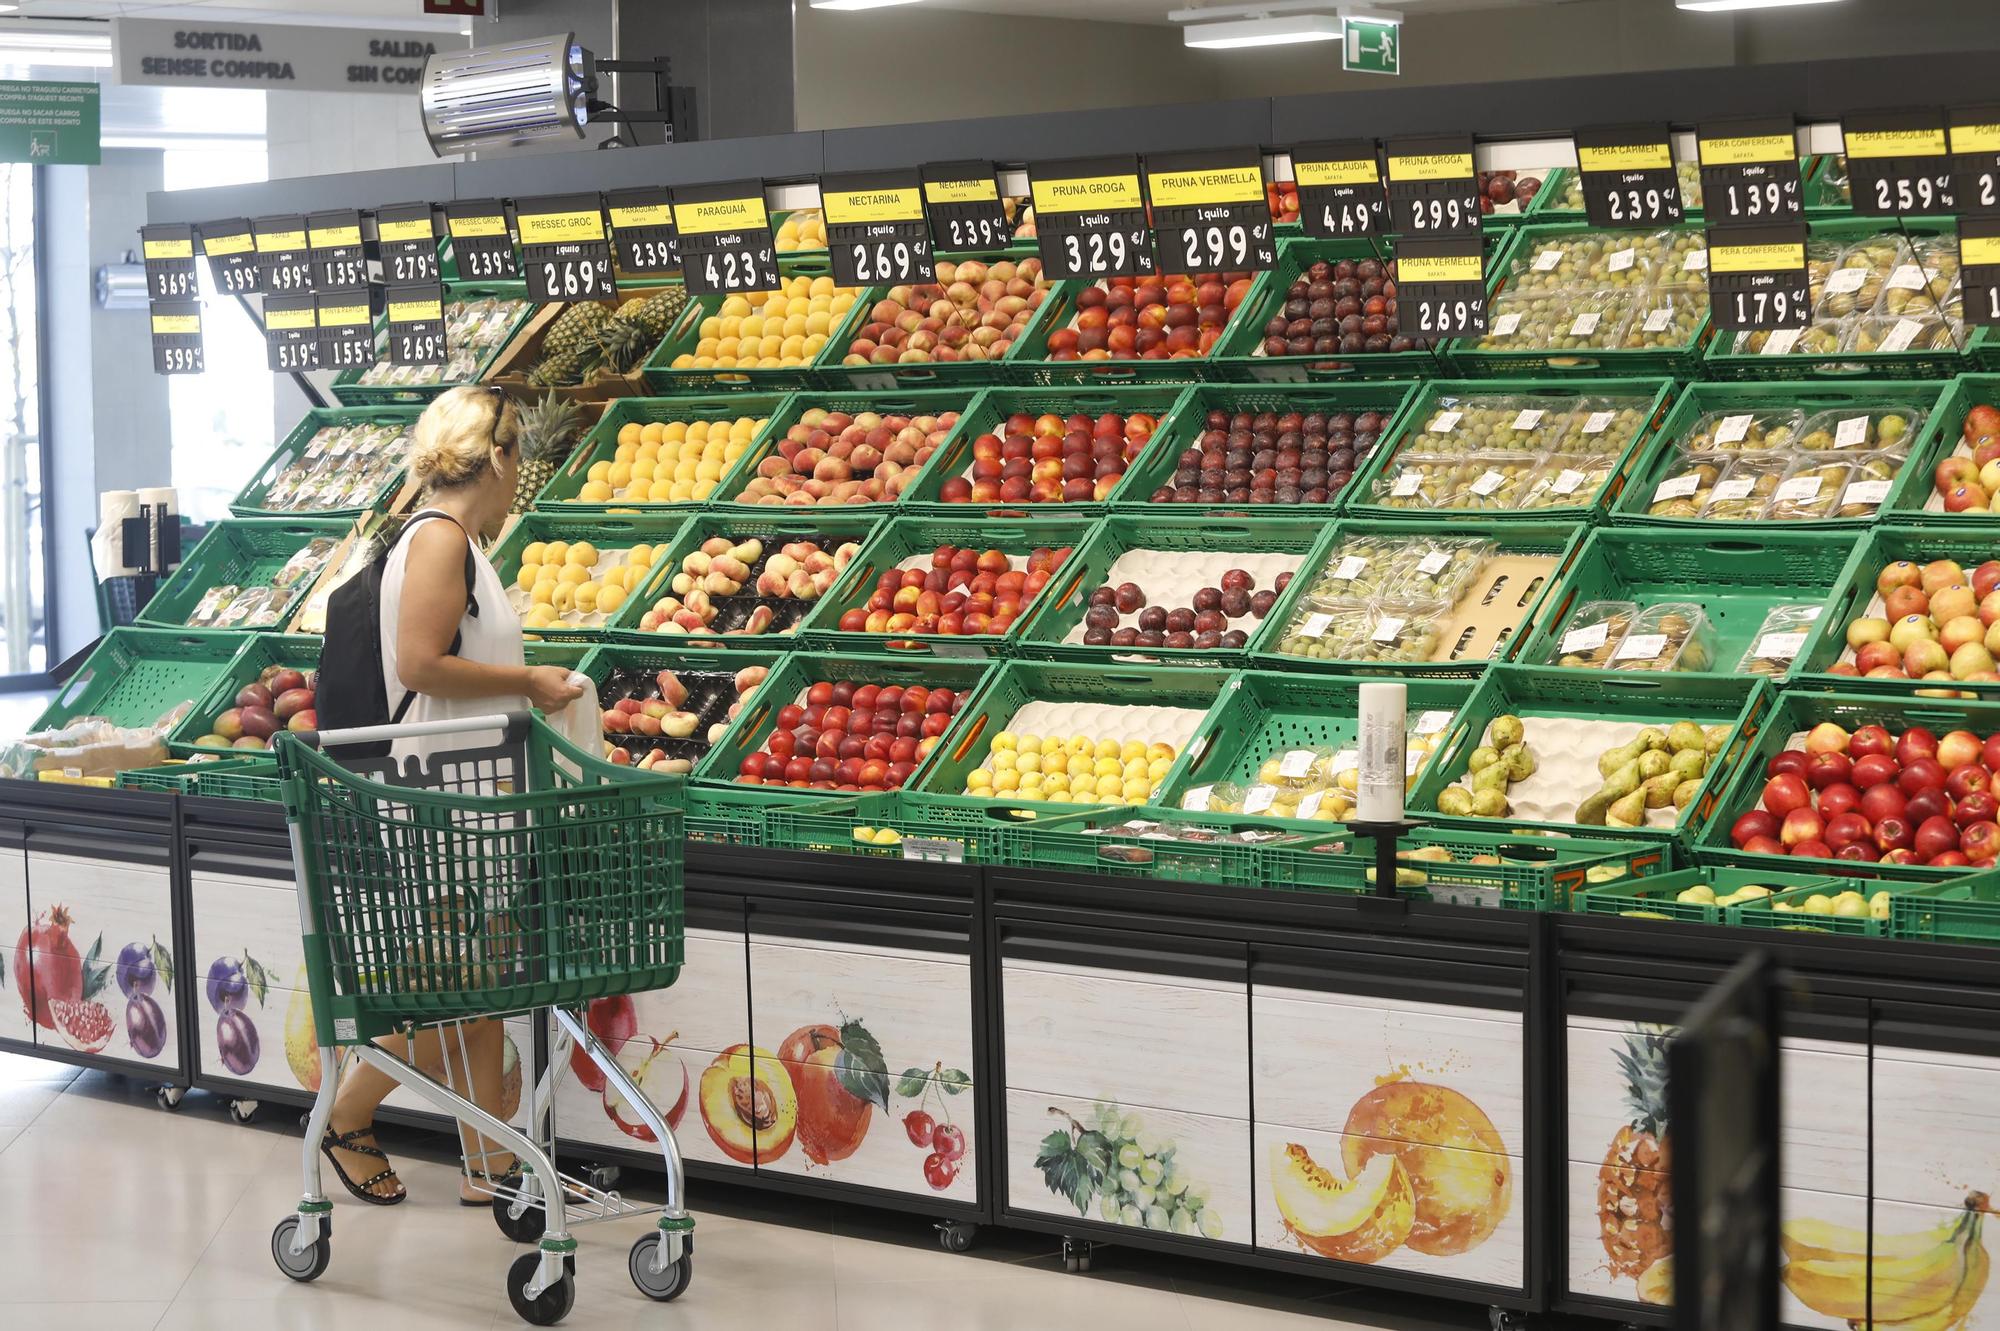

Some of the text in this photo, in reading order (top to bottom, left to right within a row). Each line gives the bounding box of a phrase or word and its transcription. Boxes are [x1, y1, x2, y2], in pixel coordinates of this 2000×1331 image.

[174, 31, 262, 51] SORTIDA
[369, 39, 437, 58] SALIDA
[141, 57, 295, 81] SENSE COMPRA
[346, 65, 377, 83] SIN
[1592, 144, 1659, 156] PERA CARMEN
[1709, 141, 1730, 149] PERA
[1301, 164, 1330, 173] PRUNA
[1400, 155, 1463, 166] PRUNA GROGA
[1052, 182, 1126, 196] PRUNA GROGA
[1162, 172, 1257, 189] PRUNA VERMELLA
[848, 194, 901, 206] NECTARINA
[1728, 182, 1780, 217] 1,39
[1787, 199, 1799, 212] kg
[1875, 177, 1933, 210] 2,59
[1941, 194, 1954, 207] kg
[1198, 207, 1230, 221] 1 quilo
[1608, 189, 1660, 221] 2,39
[1668, 206, 1679, 217] kg
[568, 217, 592, 227] GROC
[1080, 214, 1110, 228] 1 quilo
[1412, 199, 1460, 230] 2,99
[1467, 214, 1478, 226] kg
[867, 224, 895, 237] 1 quilo
[1065, 232, 1126, 273] 3,29
[1139, 255, 1152, 269] kg
[1183, 225, 1247, 267] 2,99
[1259, 249, 1272, 263] kg
[1720, 248, 1741, 256] PERA
[853, 242, 910, 280] 2,69
[919, 265, 931, 277] kg
[1402, 256, 1479, 267] PRUNA VERMELLA
[544, 261, 594, 297] 2,69
[601, 281, 612, 294] kg
[705, 252, 756, 289] 4,23
[765, 272, 776, 284] kg
[1419, 301, 1467, 332] 2,69
[1474, 317, 1484, 329] kg
[1736, 291, 1787, 324] 1,79
[1795, 308, 1807, 320] kg
